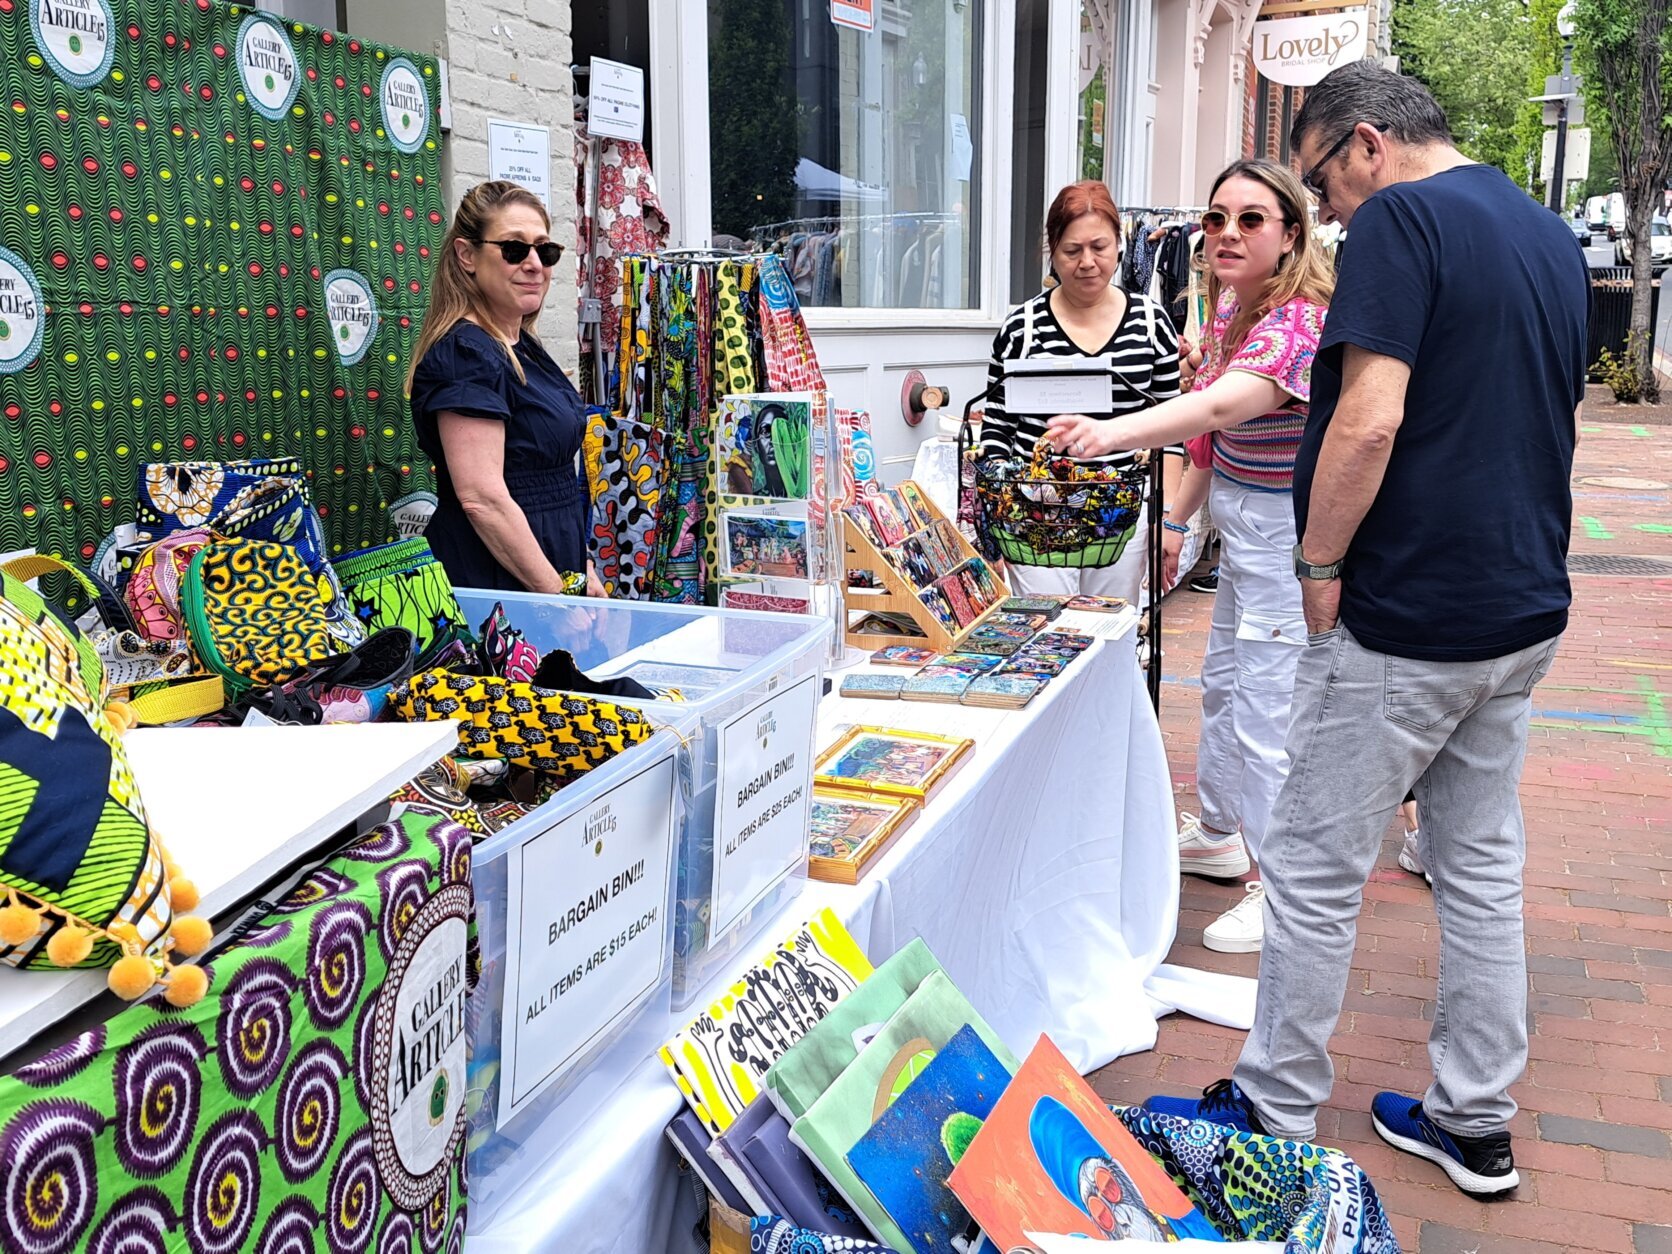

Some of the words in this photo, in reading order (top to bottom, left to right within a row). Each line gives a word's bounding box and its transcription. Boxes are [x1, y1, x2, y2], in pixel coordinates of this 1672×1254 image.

[252, 36, 282, 54] GALLERY
[1261, 20, 1359, 66] Lovely
[1307, 57, 1326, 65] SHOP
[393, 80, 416, 95] GALLERY
[330, 293, 360, 305] GALLERY
[331, 305, 366, 322] RTICLE
[737, 766, 773, 808] BARGAIN
[774, 753, 795, 781] BIN!!!
[589, 803, 611, 825] GALLERY
[725, 837, 737, 859] ALL
[738, 819, 757, 847] ITEMS
[757, 808, 771, 830] ARE
[771, 799, 783, 819] $25
[783, 784, 803, 809] EACH!
[548, 883, 609, 946] BARGAIN
[612, 859, 645, 898] BIN!!!
[525, 995, 547, 1025] ALL
[550, 964, 583, 1005] ITEMS
[585, 945, 607, 976] ARE
[608, 930, 627, 957] $15
[628, 906, 658, 942] EACH!
[412, 953, 463, 1032] GALLERY
[1342, 1160, 1360, 1238] PRIMA
